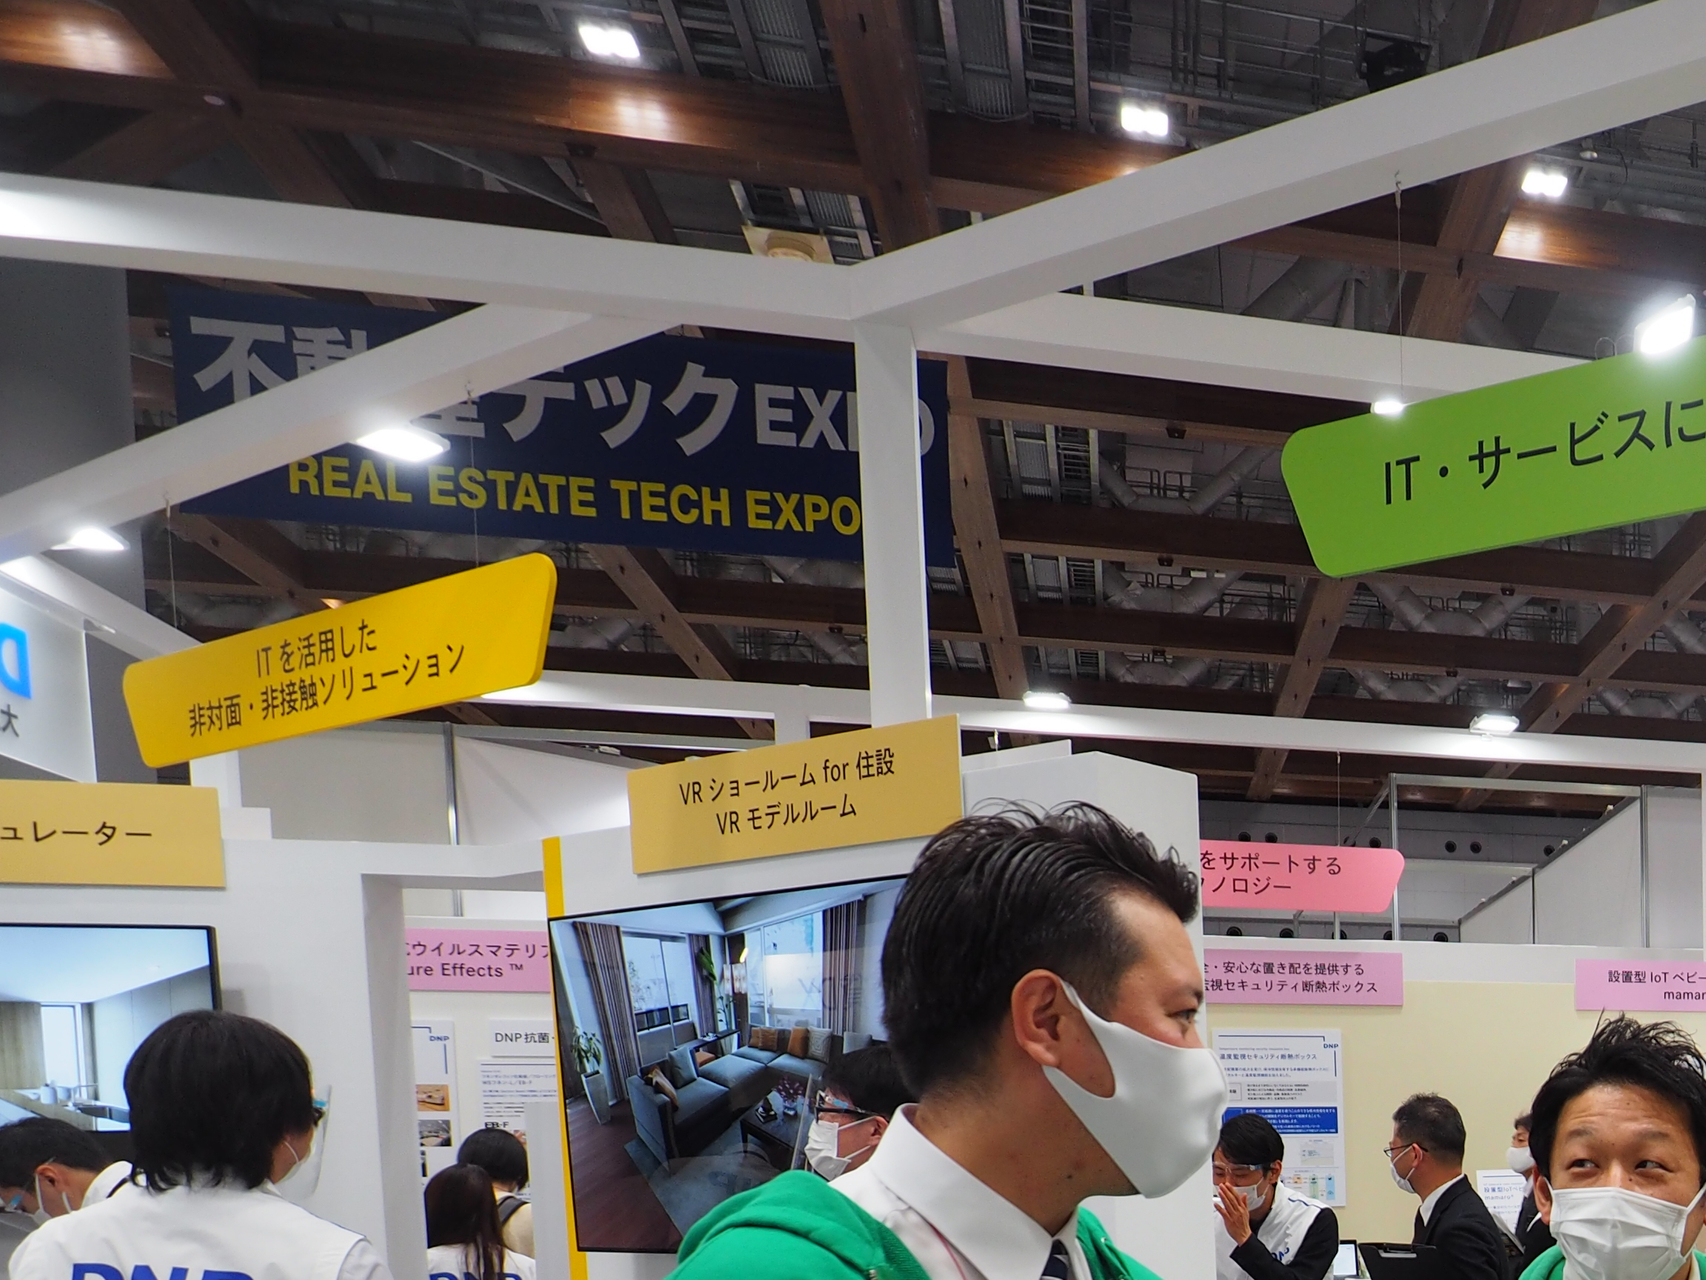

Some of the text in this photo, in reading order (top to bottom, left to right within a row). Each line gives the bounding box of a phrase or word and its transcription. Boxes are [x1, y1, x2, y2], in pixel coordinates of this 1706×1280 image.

[288, 455, 862, 536] REAL ESTATE TECH EXPO
[279, 617, 377, 674] を活用した
[188, 643, 466, 739] 非対面・非接触ソリューション
[679, 747, 896, 806] VR ショールーム for 住設
[716, 793, 857, 835] VR モデルルーム
[1201, 876, 1292, 896] ノロジー
[441, 962, 504, 978] Effects
[1608, 969, 1647, 984] 設置型
[1650, 971, 1669, 984] IoT
